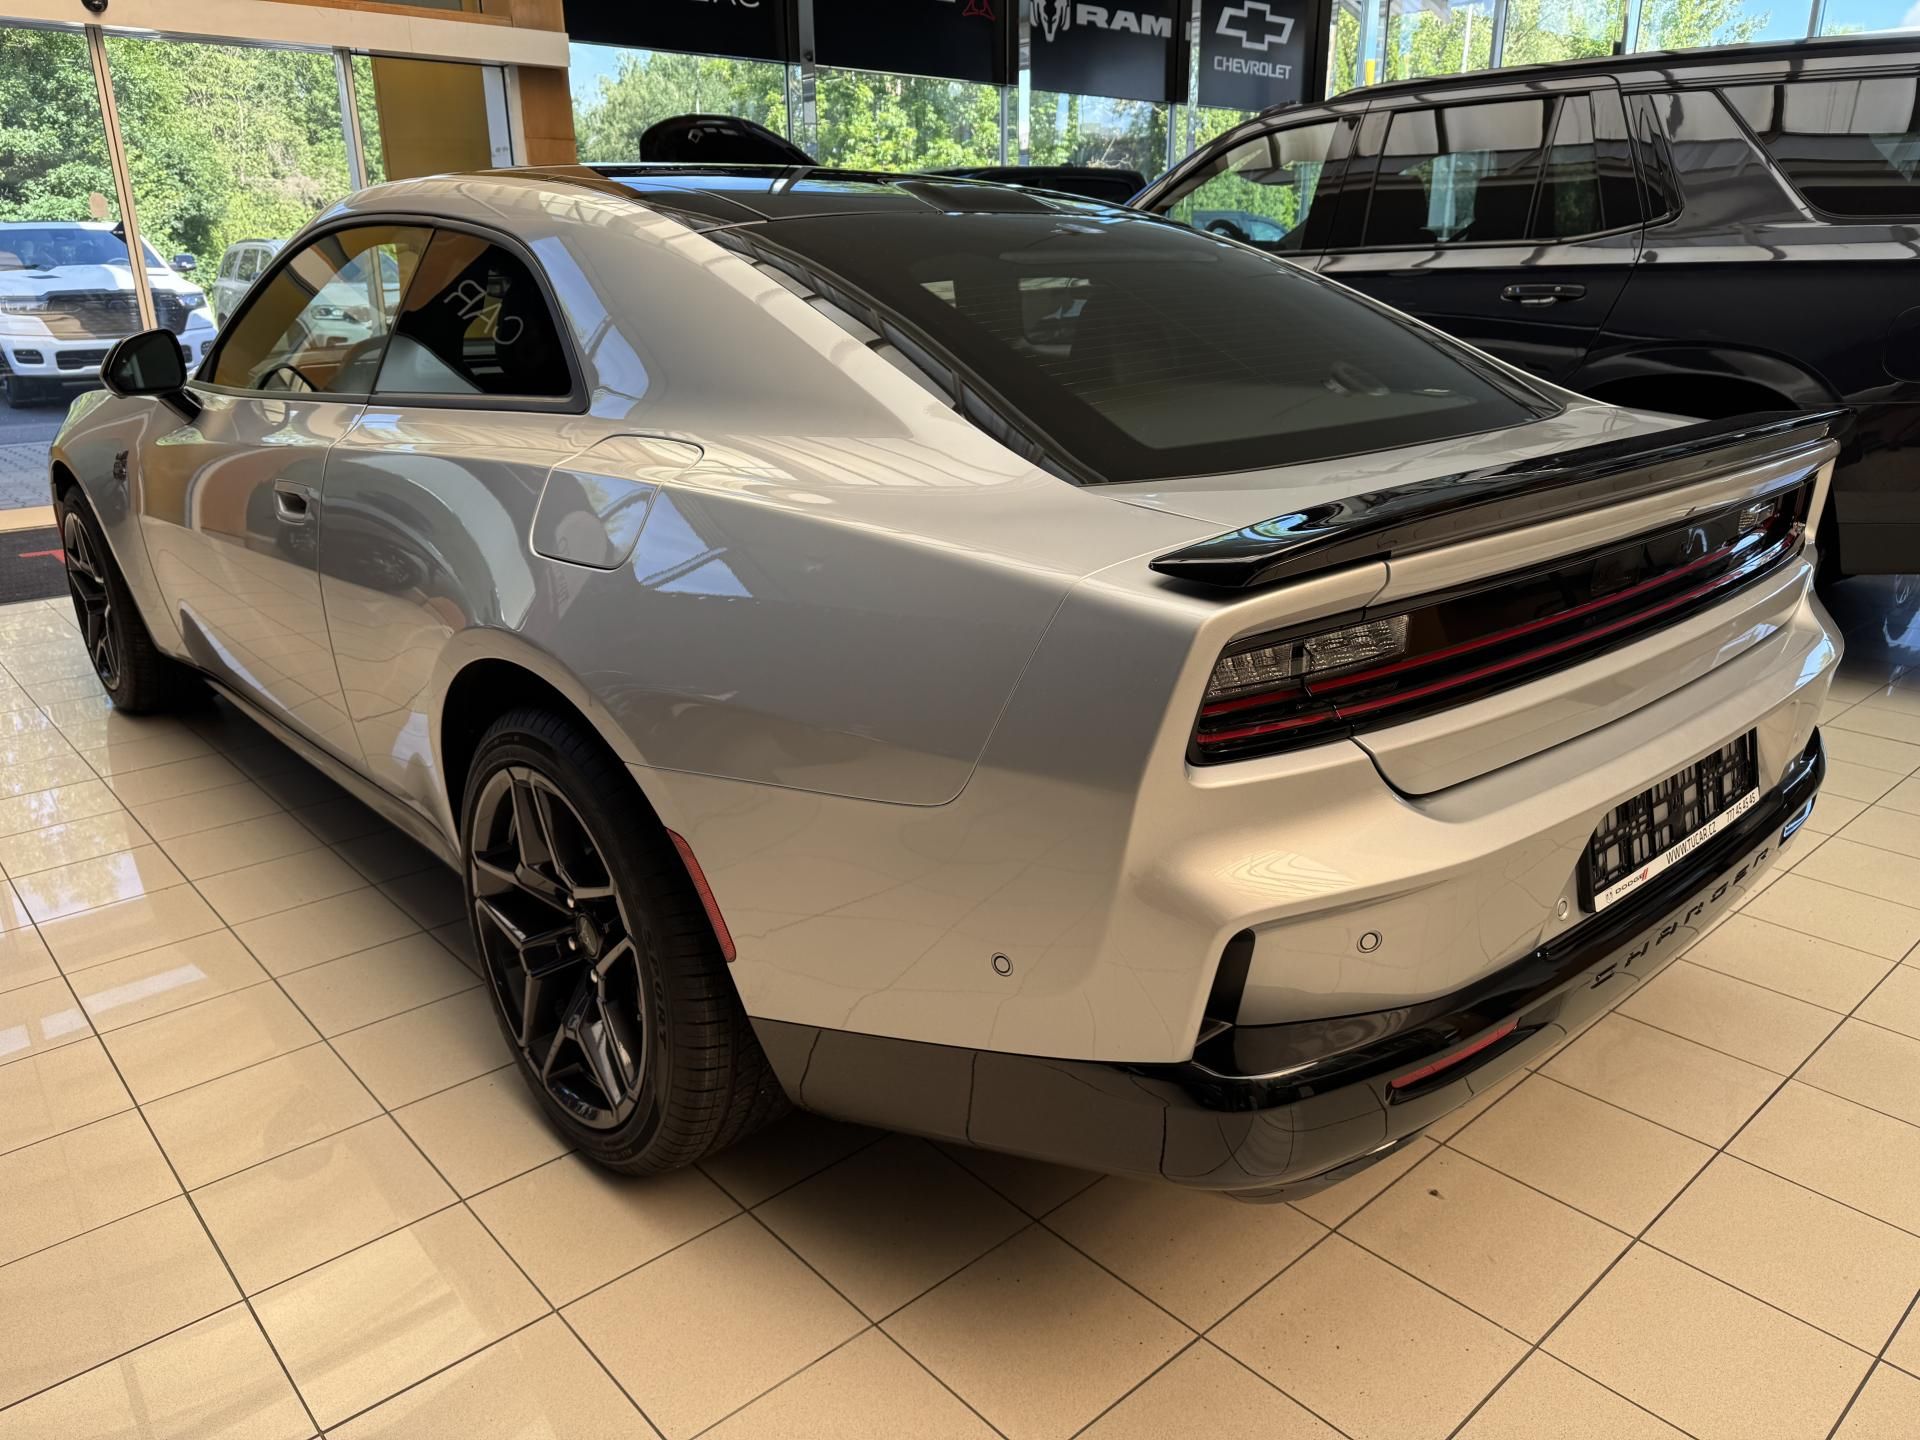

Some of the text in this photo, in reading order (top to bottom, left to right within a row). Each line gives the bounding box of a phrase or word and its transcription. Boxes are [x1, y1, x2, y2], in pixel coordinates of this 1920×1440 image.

[1076, 3, 1172, 38] RAM
[1213, 55, 1292, 80] CHEVROLET
[1665, 821, 1717, 864] WWW.TUCAR.CZ
[1726, 808, 1735, 823] 777
[1590, 848, 1769, 989] CHARGER
